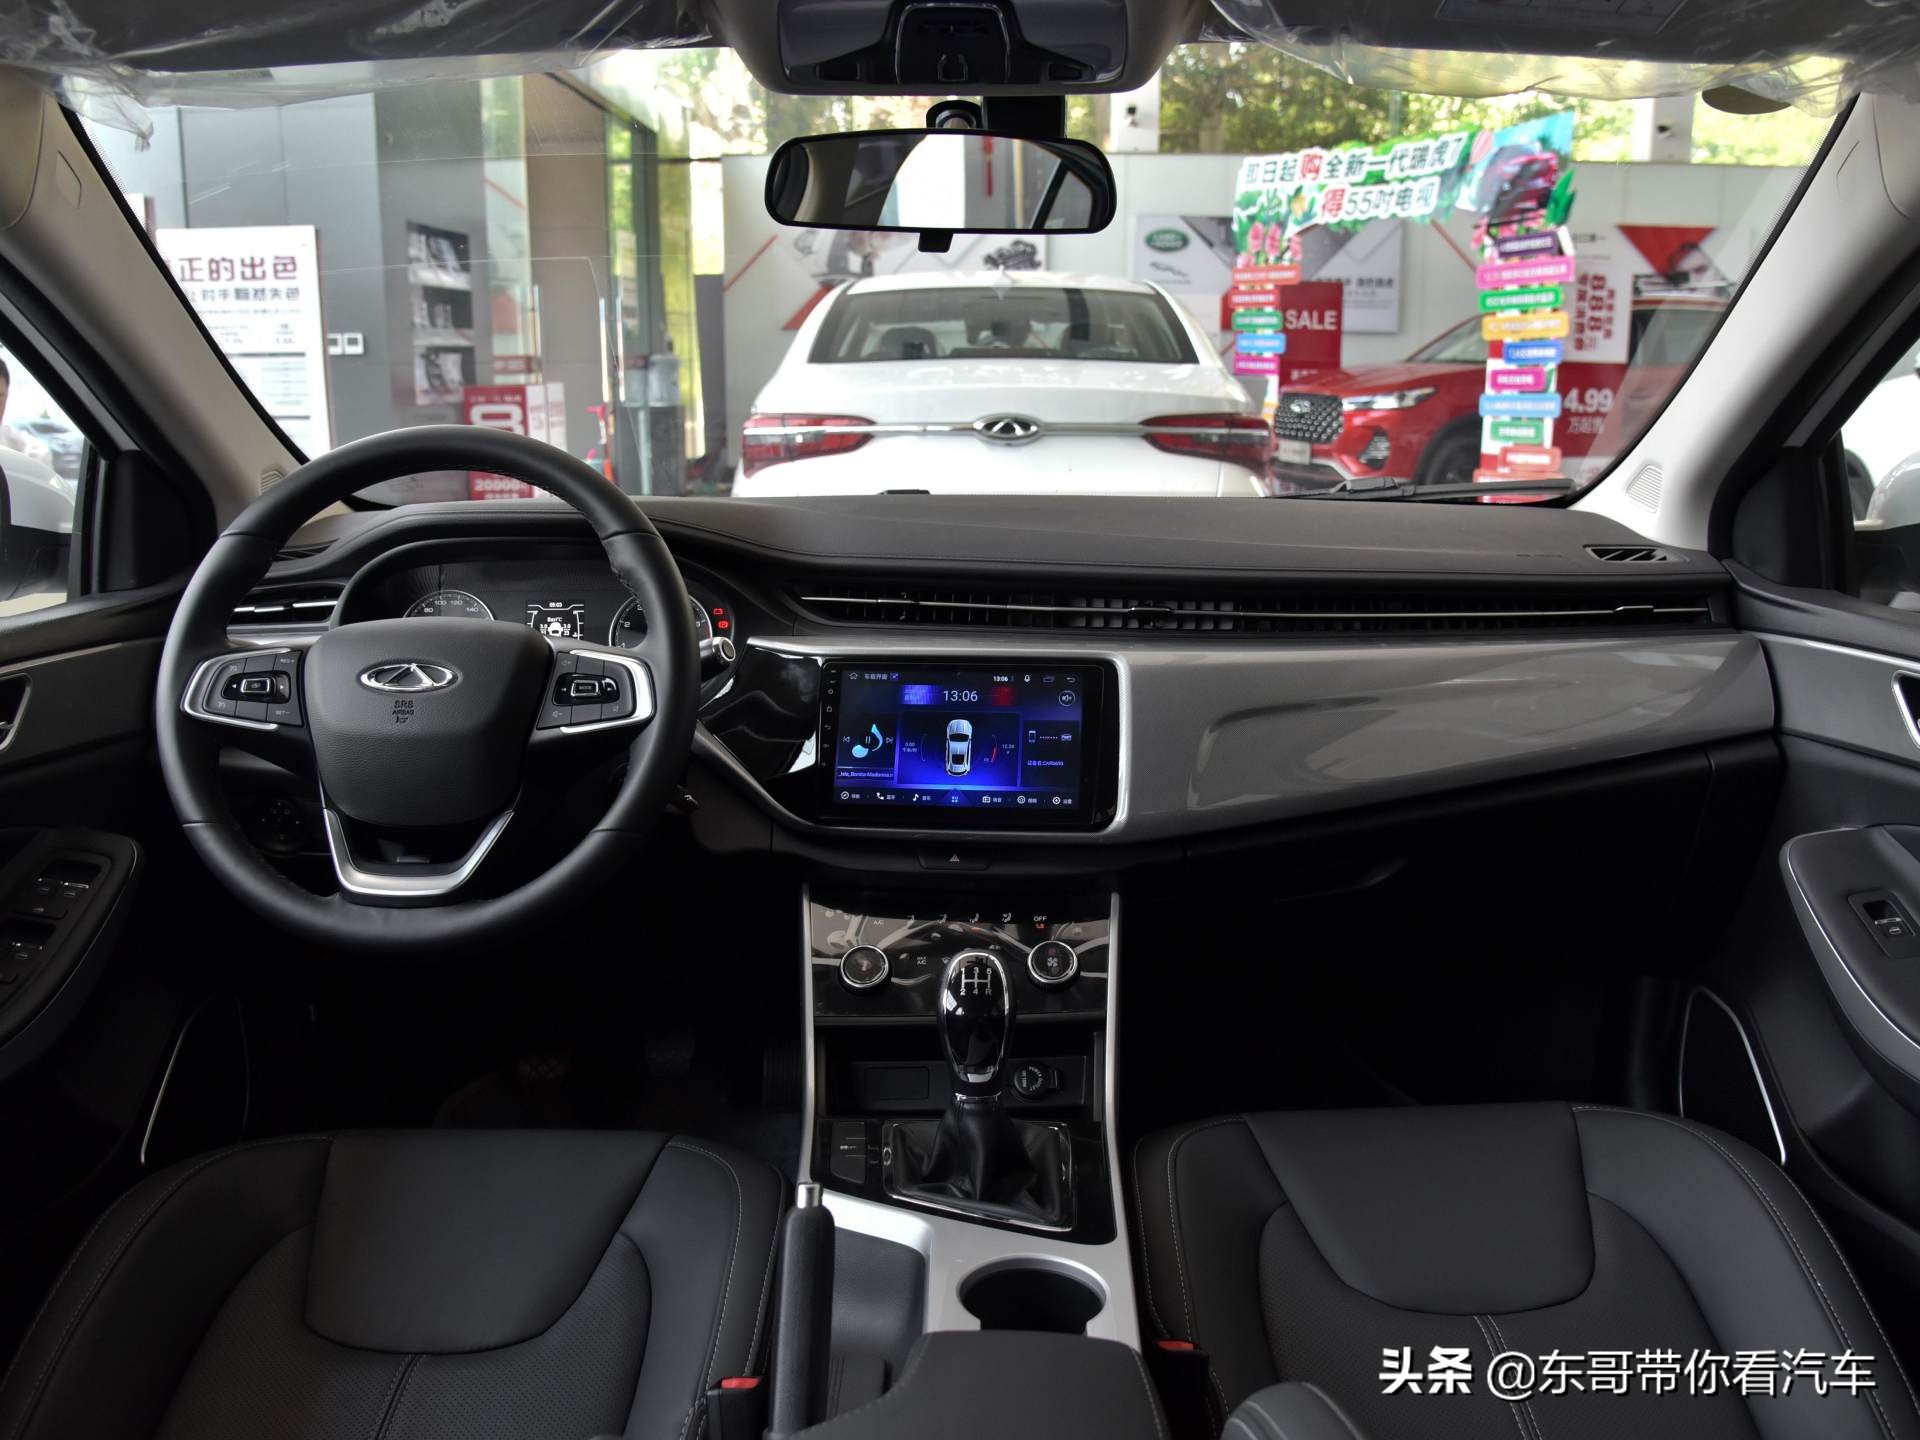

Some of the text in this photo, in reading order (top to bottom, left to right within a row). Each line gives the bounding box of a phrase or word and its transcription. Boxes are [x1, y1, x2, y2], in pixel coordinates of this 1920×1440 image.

[168, 255, 298, 282] 正的出色
[1285, 308, 1338, 330] SALE
[1564, 387, 1613, 413] 4.99
[394, 700, 414, 709] SRS
[943, 690, 978, 702] 13:06
